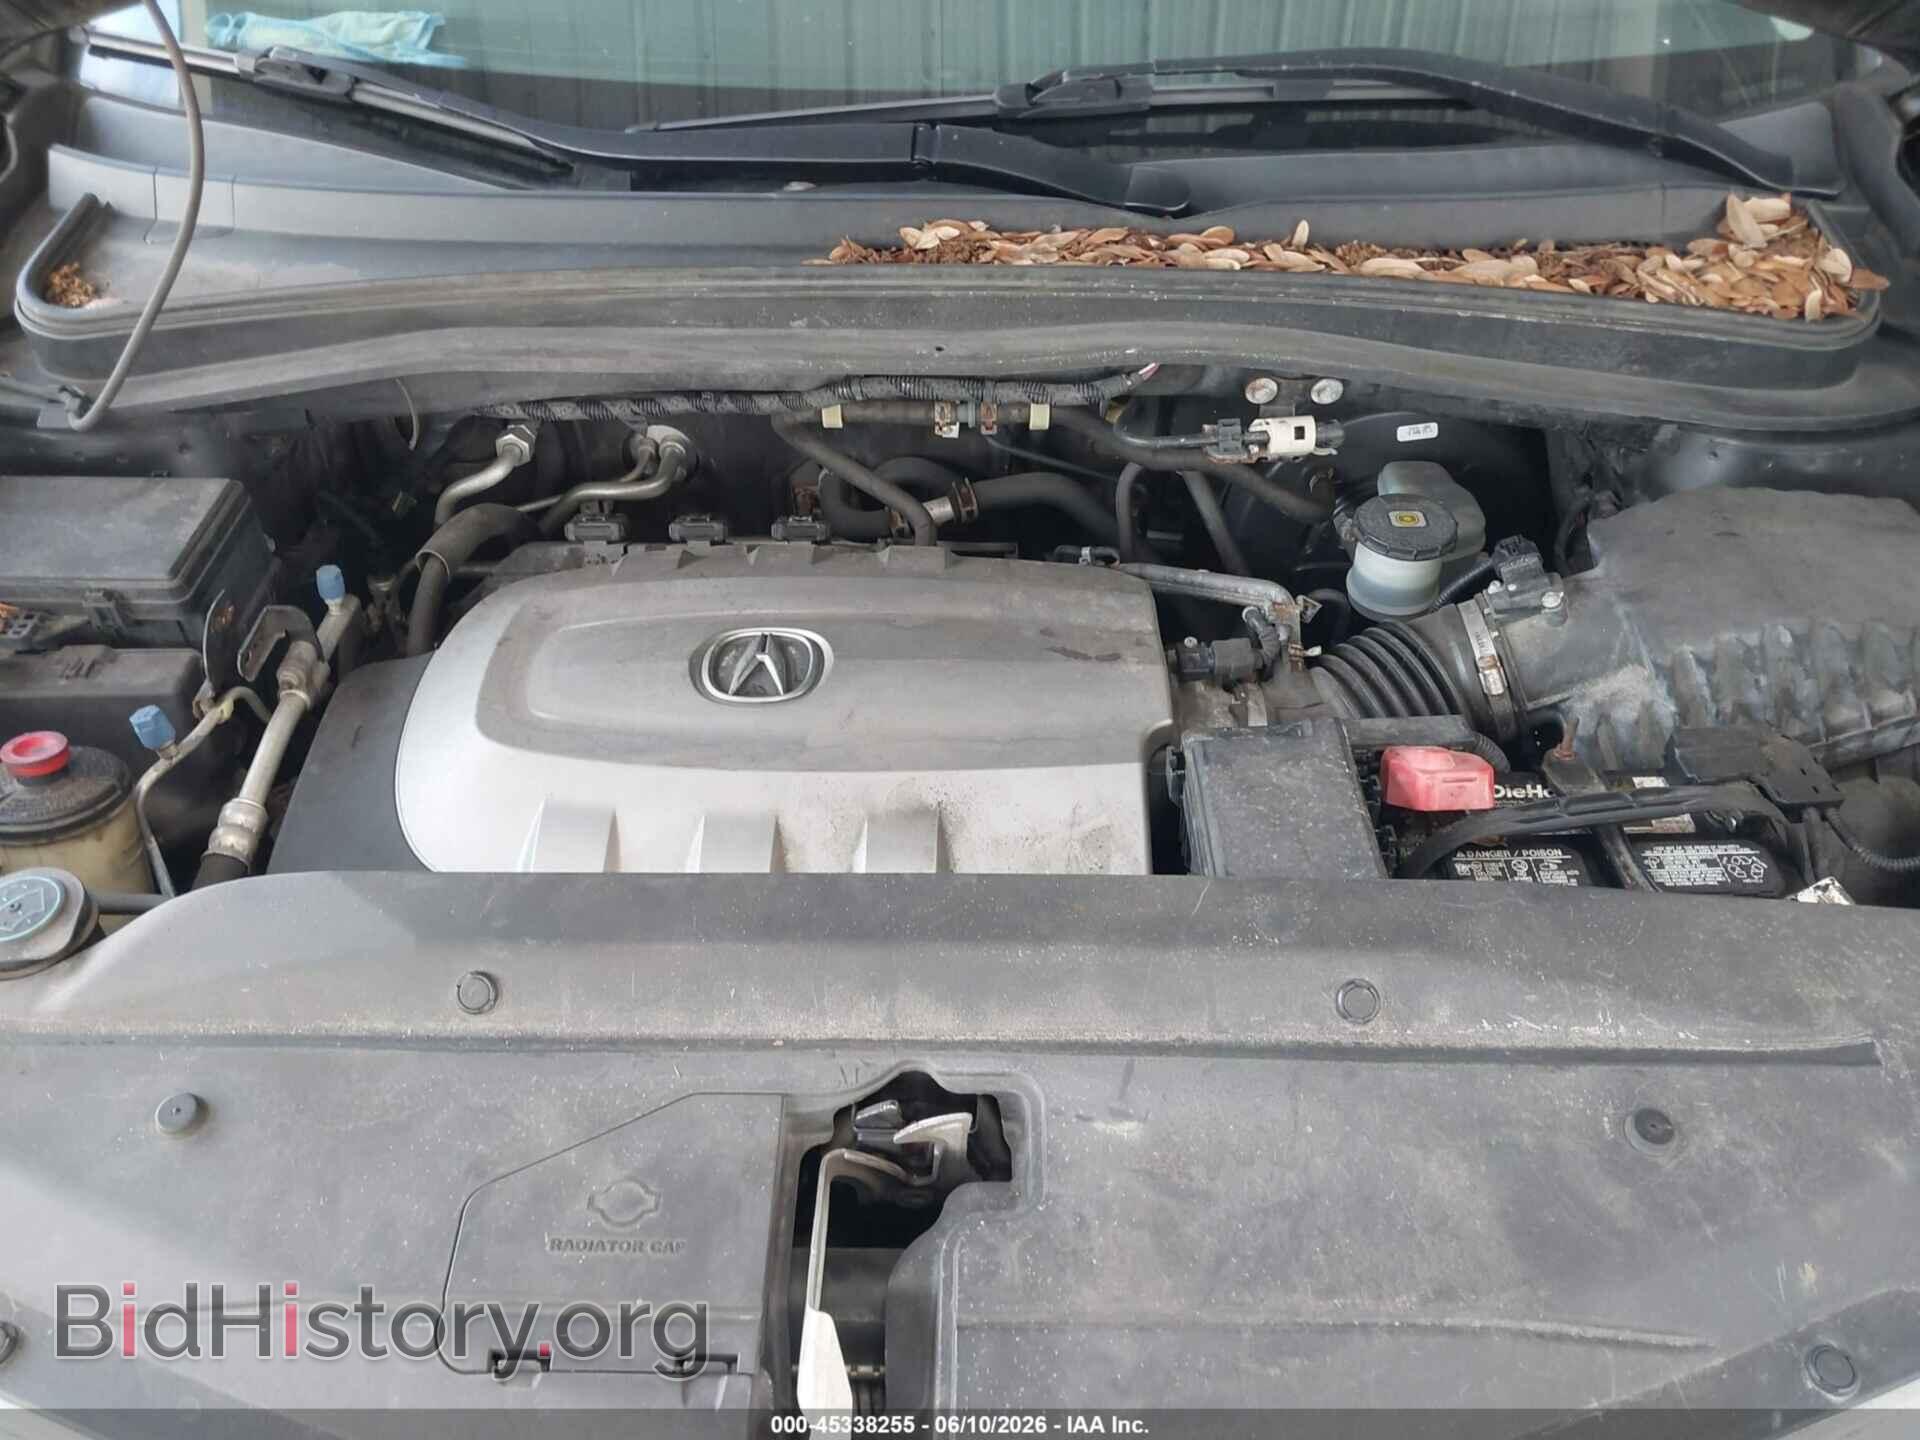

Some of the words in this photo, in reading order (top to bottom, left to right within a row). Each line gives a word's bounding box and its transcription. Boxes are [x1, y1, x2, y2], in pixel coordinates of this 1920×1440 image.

[1466, 850, 1511, 858] DANGER
[1521, 848, 1562, 857] POISON
[546, 1236, 644, 1253] RADIATOR
[650, 1237, 685, 1254] CAP
